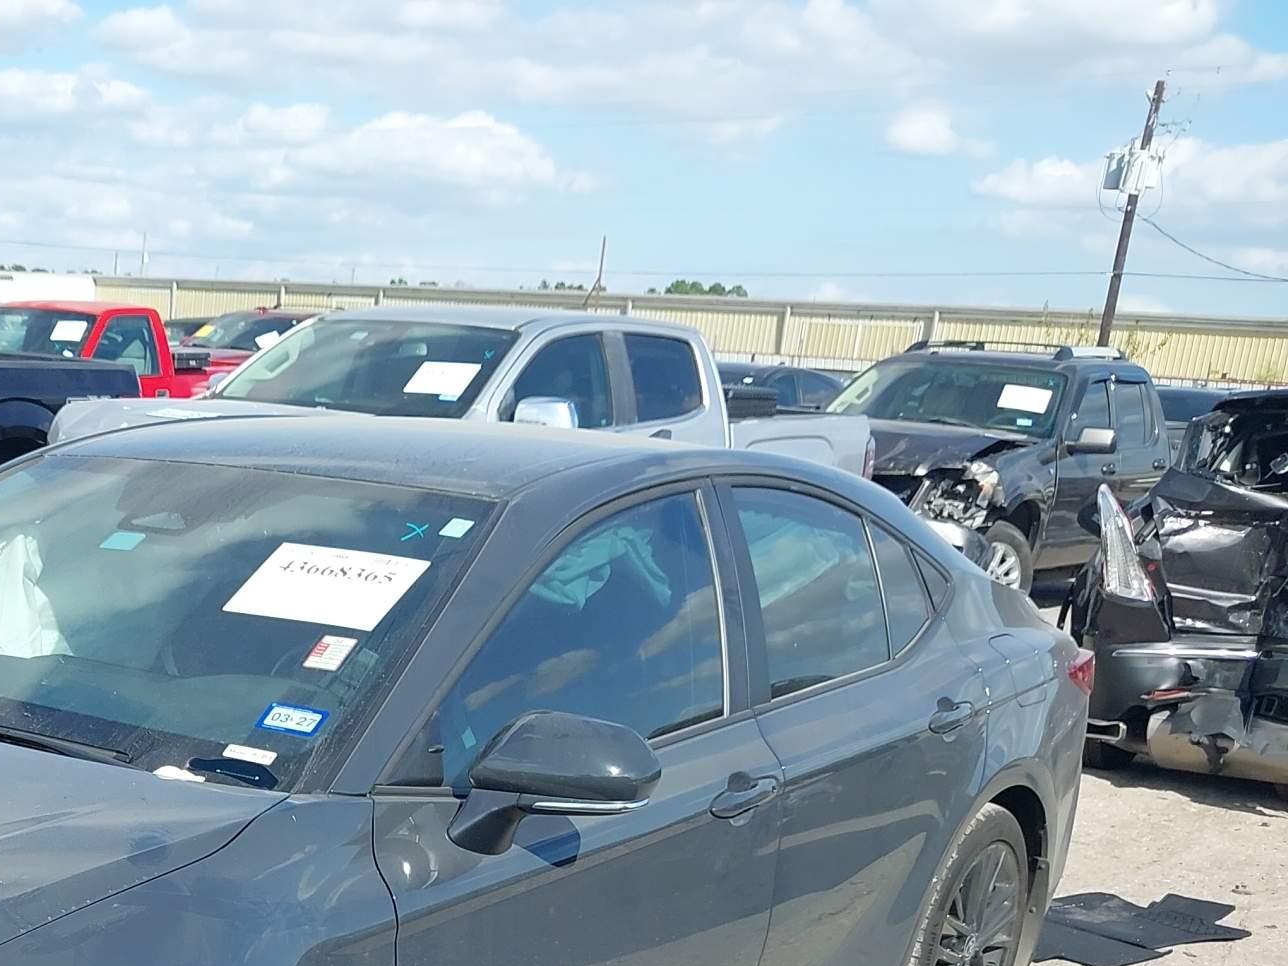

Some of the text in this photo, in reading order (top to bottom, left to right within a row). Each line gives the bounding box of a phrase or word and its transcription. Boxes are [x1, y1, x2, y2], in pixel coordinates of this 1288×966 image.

[279, 560, 398, 584] 43668365
[270, 711, 318, 728] 03 27
